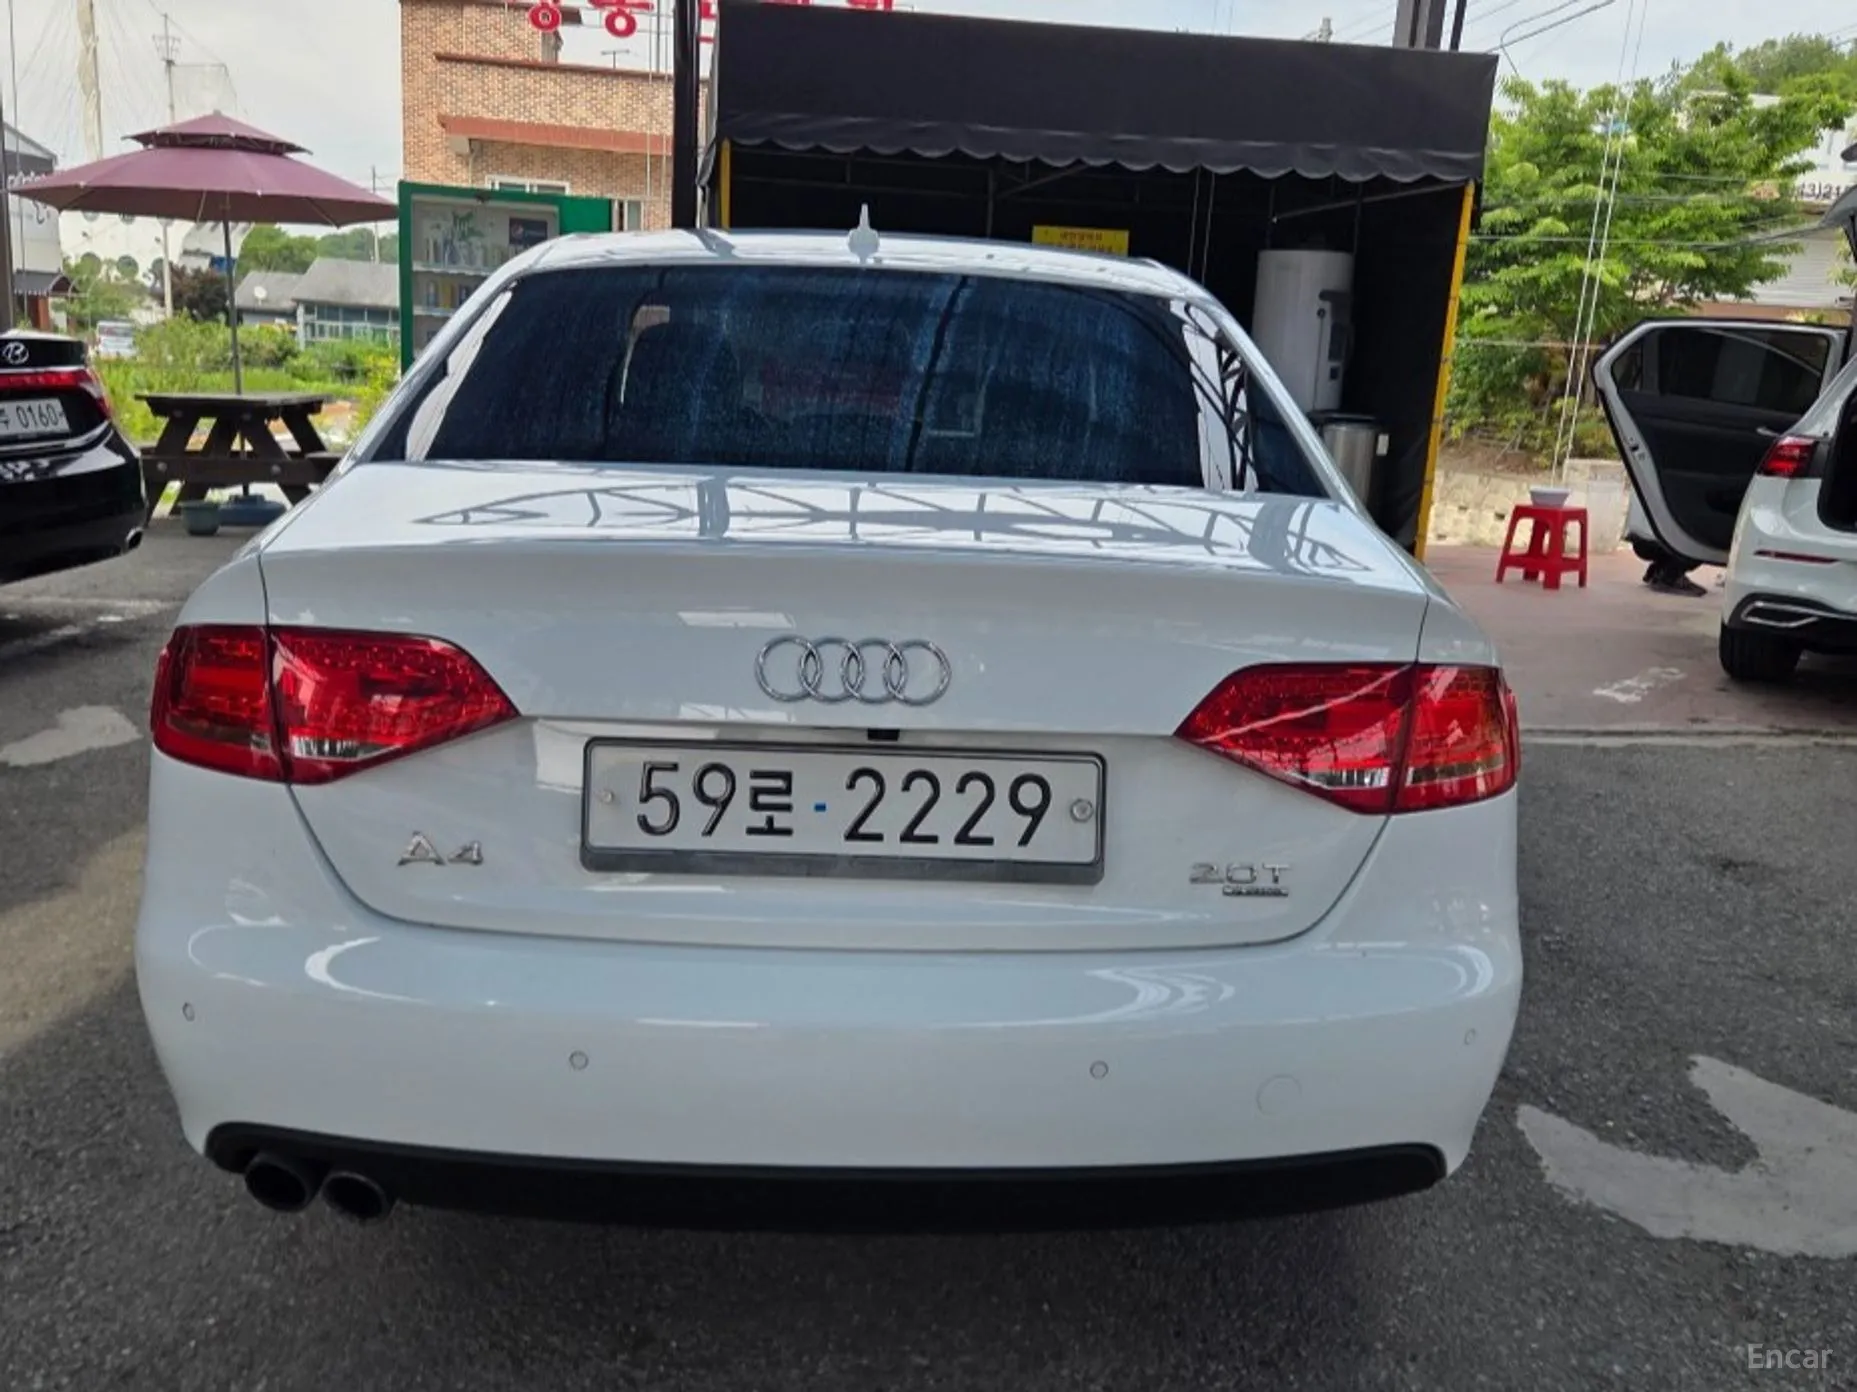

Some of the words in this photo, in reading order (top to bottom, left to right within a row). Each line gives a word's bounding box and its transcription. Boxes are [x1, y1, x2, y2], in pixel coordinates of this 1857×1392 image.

[15, 404, 59, 428] 0160
[636, 760, 794, 837] 59로
[842, 766, 1052, 847] 2229
[397, 830, 484, 867] A4
